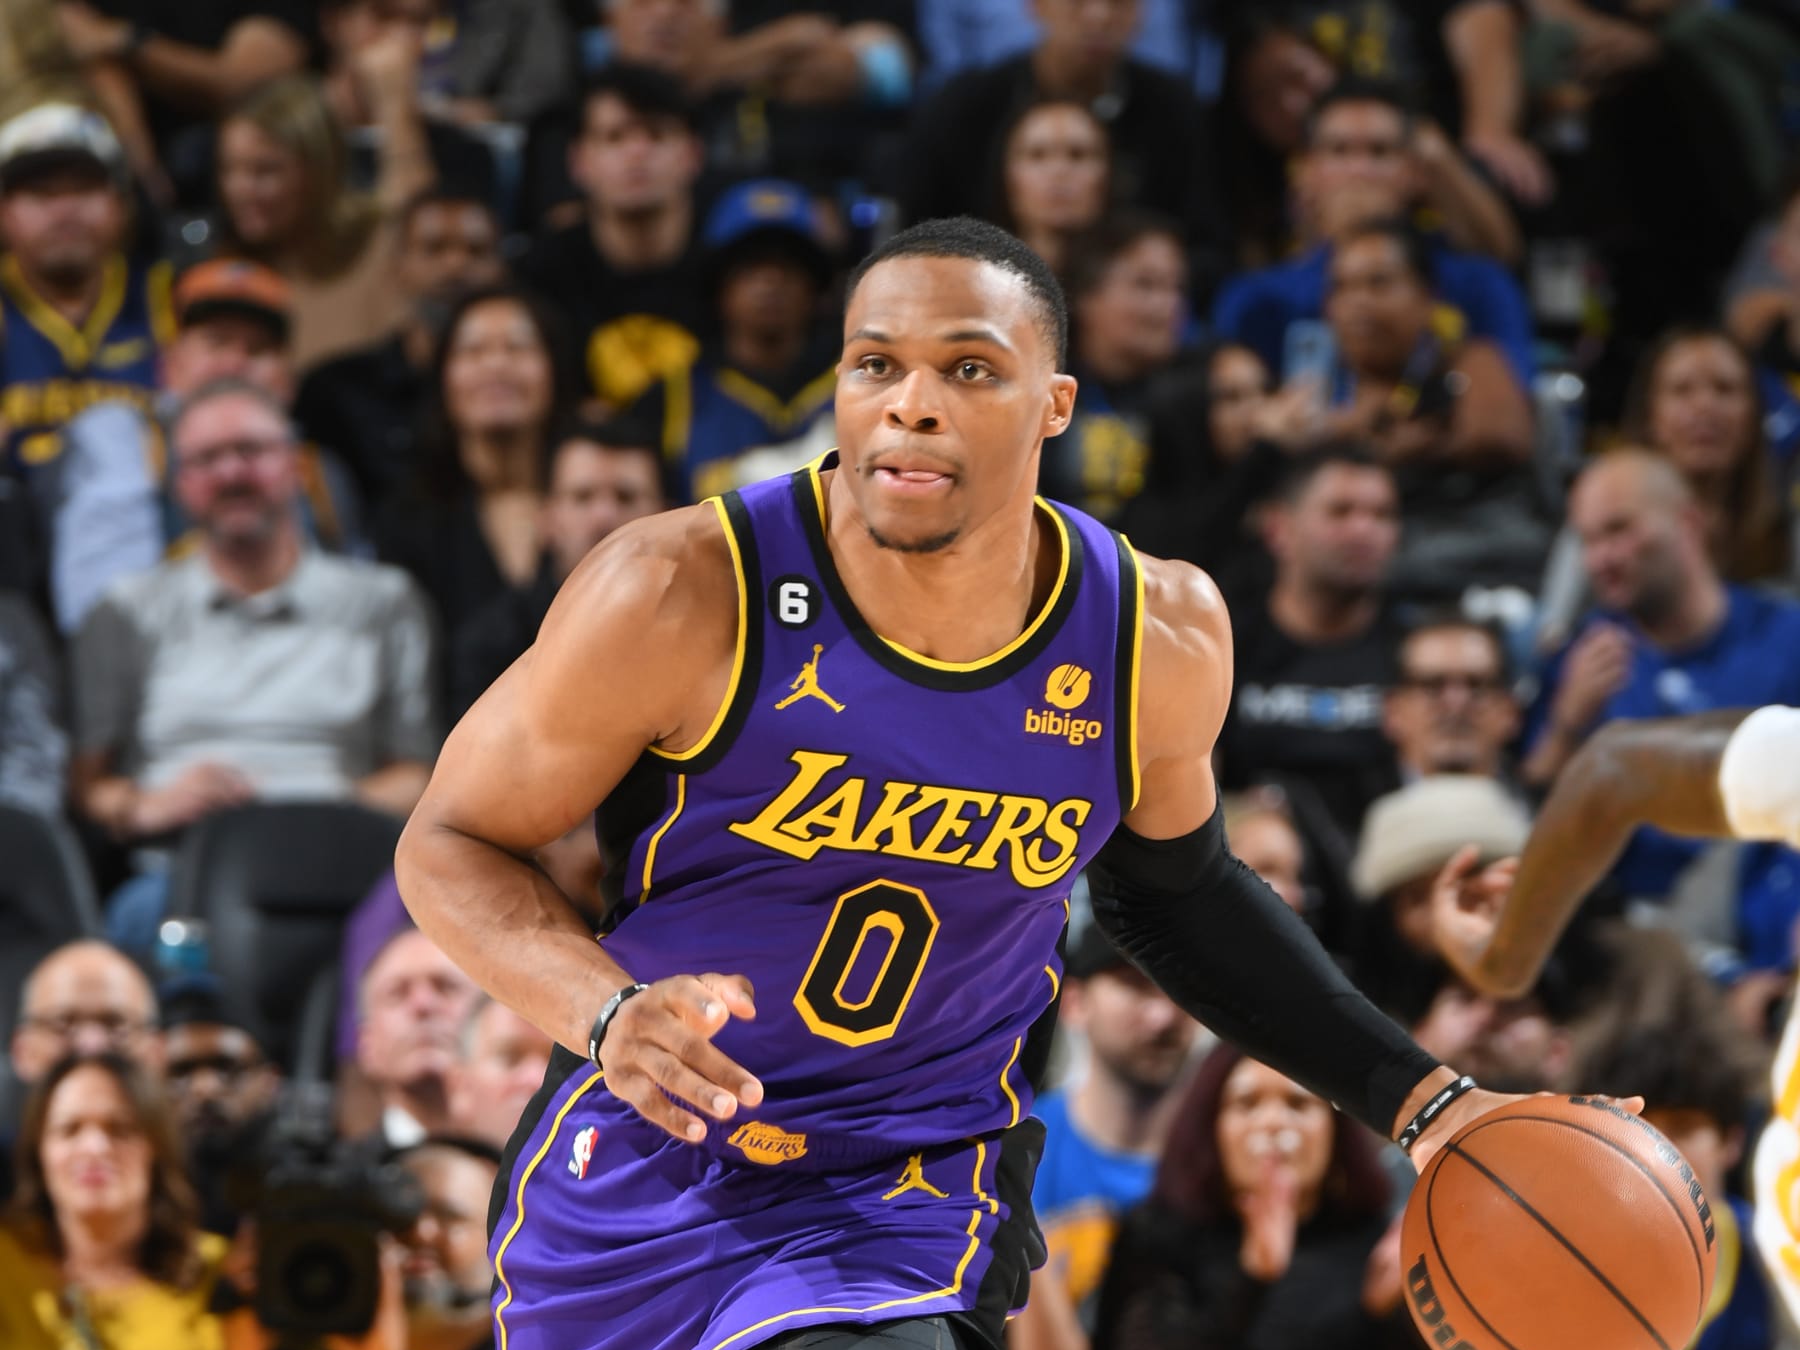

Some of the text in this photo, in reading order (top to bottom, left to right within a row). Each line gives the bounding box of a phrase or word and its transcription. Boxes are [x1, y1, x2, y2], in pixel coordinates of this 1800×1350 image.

[779, 582, 809, 623] 6
[1024, 708, 1102, 746] bibigo
[729, 751, 1092, 888] LAKERS
[792, 878, 942, 1048] 0
[732, 1128, 804, 1159] LAKERS
